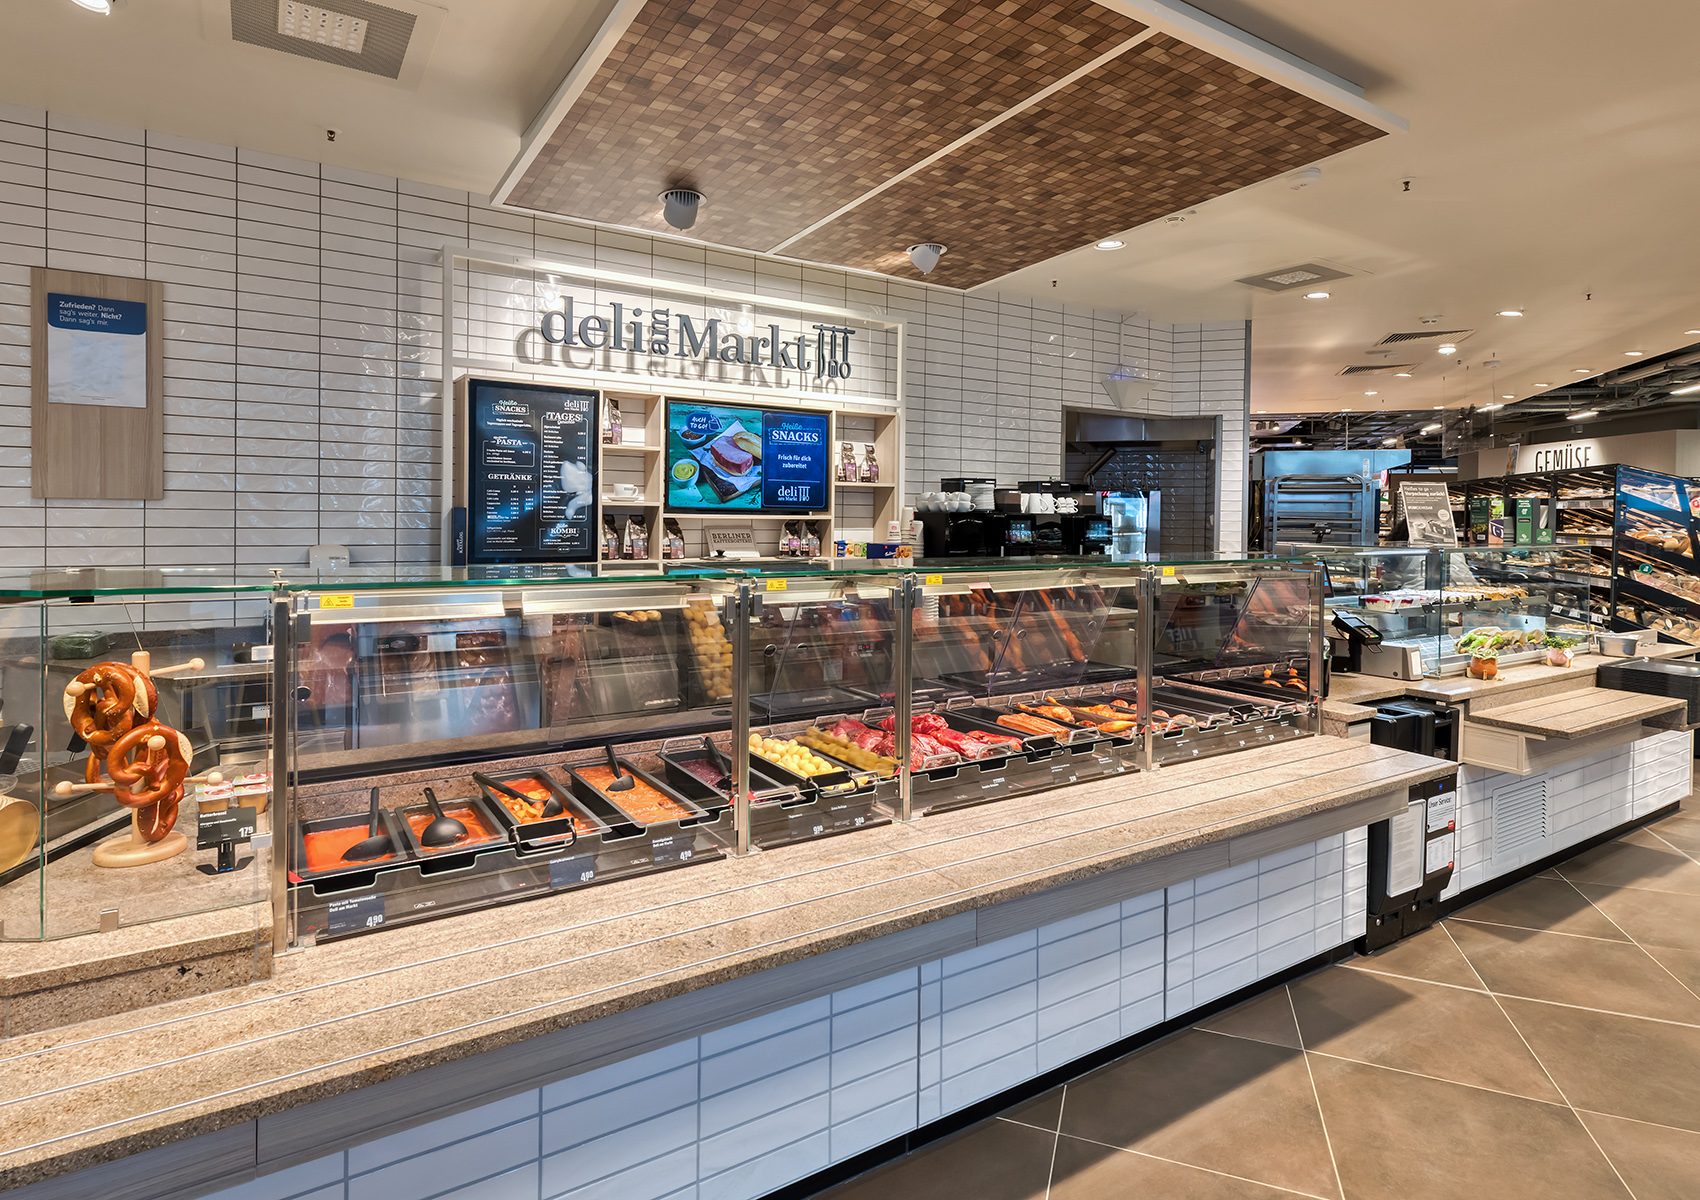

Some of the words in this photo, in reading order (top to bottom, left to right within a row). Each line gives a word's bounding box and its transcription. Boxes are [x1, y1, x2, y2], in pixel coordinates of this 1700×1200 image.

[59, 300, 96, 311] Zufrieden?
[97, 304, 115, 313] Dann
[59, 315, 77, 323] Dann
[78, 317, 96, 326] sag's
[77, 310, 100, 319] weiter.
[100, 312, 123, 321] Nicht?
[541, 295, 646, 353] deli
[651, 308, 670, 355] am
[674, 313, 812, 371] Markt
[564, 399, 580, 408] deli
[494, 405, 526, 414] SNACKS
[549, 412, 581, 422] TAGES
[781, 422, 803, 430] Heiße
[772, 430, 819, 442] SNACKS
[488, 473, 532, 481] GETRÄNKE
[777, 485, 797, 497] deli
